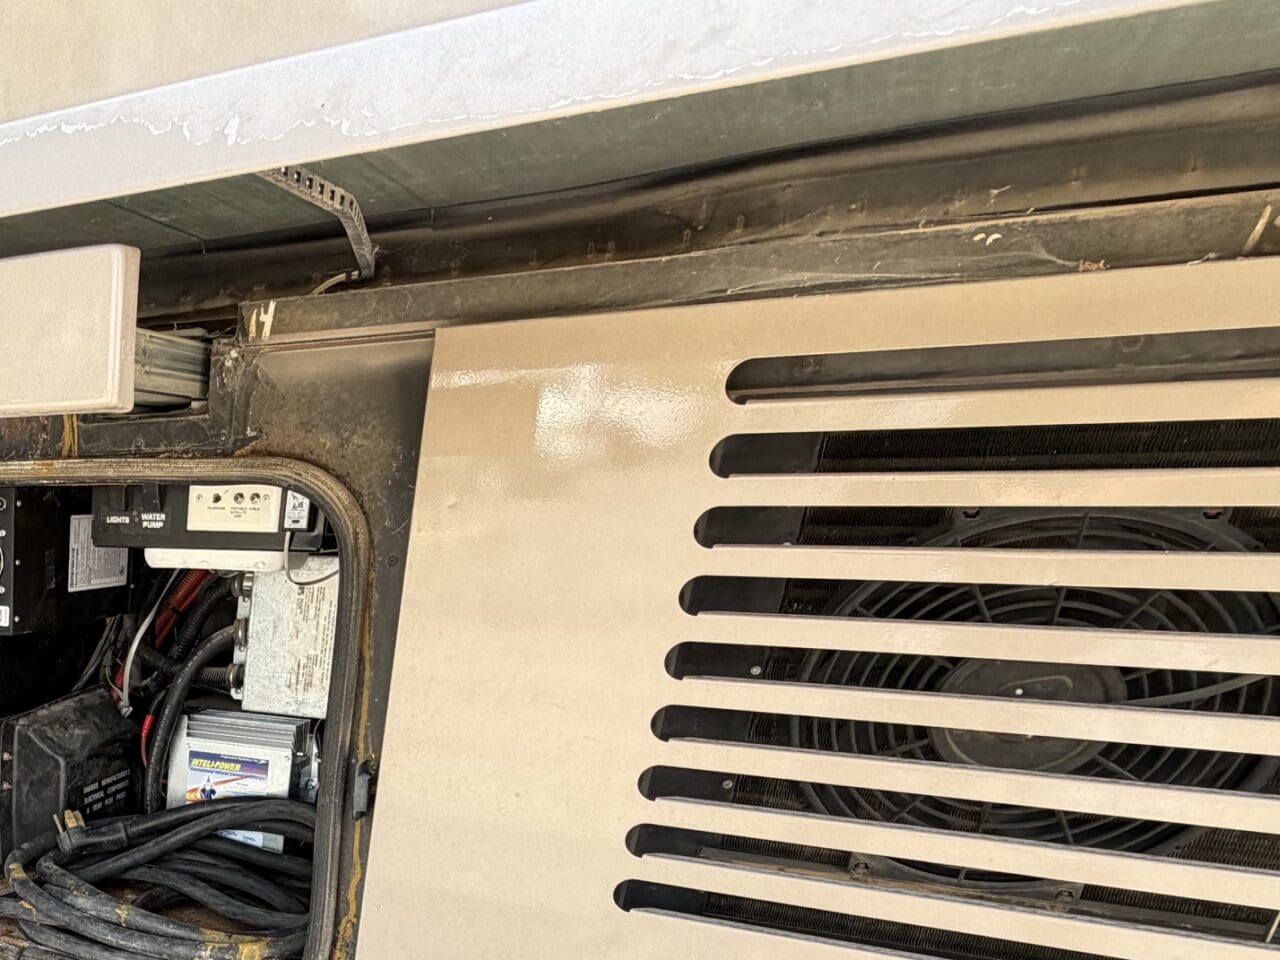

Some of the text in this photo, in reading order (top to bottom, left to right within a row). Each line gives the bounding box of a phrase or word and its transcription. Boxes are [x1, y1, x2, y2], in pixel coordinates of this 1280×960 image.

[106, 515, 130, 524] LIGHTS
[141, 513, 166, 521] WATER
[142, 521, 164, 529] PUMP
[191, 758, 241, 772] INTELI-POWER
